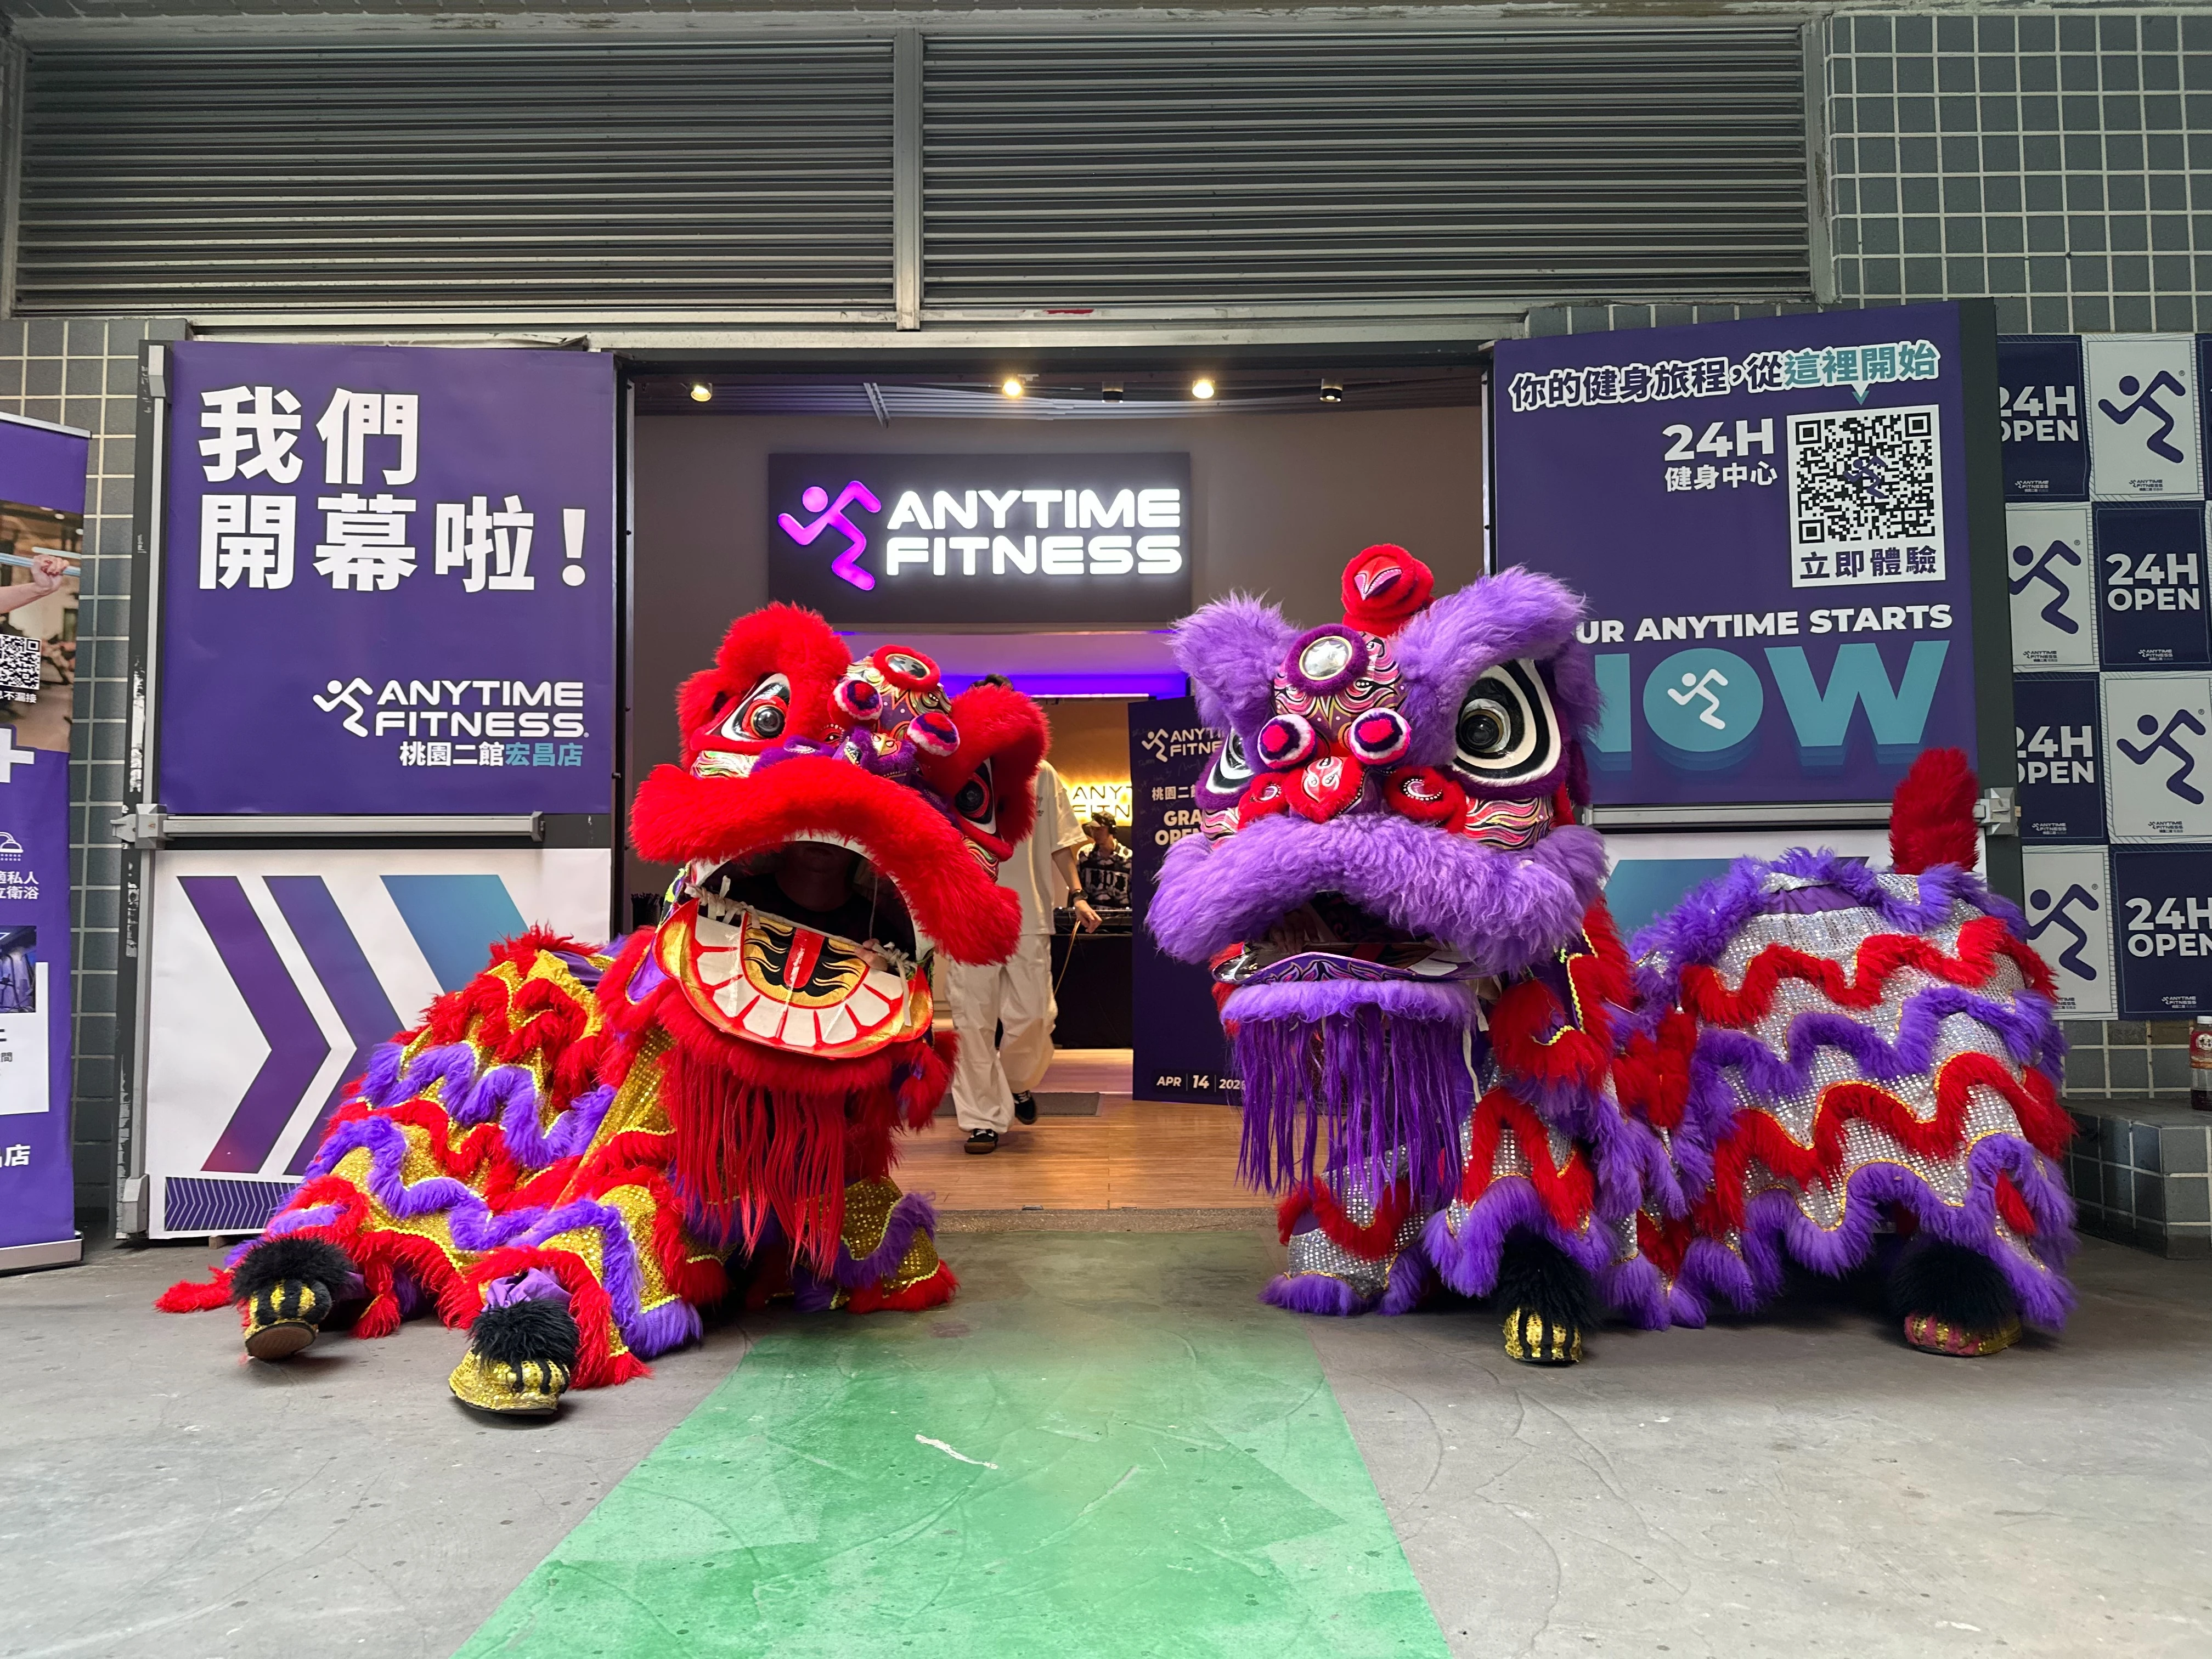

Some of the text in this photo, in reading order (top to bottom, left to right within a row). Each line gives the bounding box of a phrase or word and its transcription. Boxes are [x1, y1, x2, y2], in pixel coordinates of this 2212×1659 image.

[199, 386, 420, 485] 我們
[1662, 418, 1775, 461] 24H
[1664, 461, 1778, 493] 健身中心
[887, 488, 1181, 530] ANYTIME
[887, 534, 1183, 576] FITNESS
[1800, 544, 1937, 580] 立即體驗
[2106, 553, 2198, 585] 24H
[2108, 588, 2200, 611] OPEN
[1634, 611, 1799, 642] ANYTIME
[1810, 604, 1953, 634] STARTS
[377, 680, 583, 707] ANYTIME
[375, 712, 584, 737] FITNESS
[400, 742, 583, 766] 桃園二館宏昌店
[2018, 761, 2094, 783] PEN
[1155, 828, 1201, 846] OP
[2125, 898, 2212, 930] 24H
[2128, 933, 2212, 957] OPEN
[1156, 1076, 1182, 1086] APR
[1193, 1075, 1210, 1089] 14
[0, 1144, 31, 1168] 店
